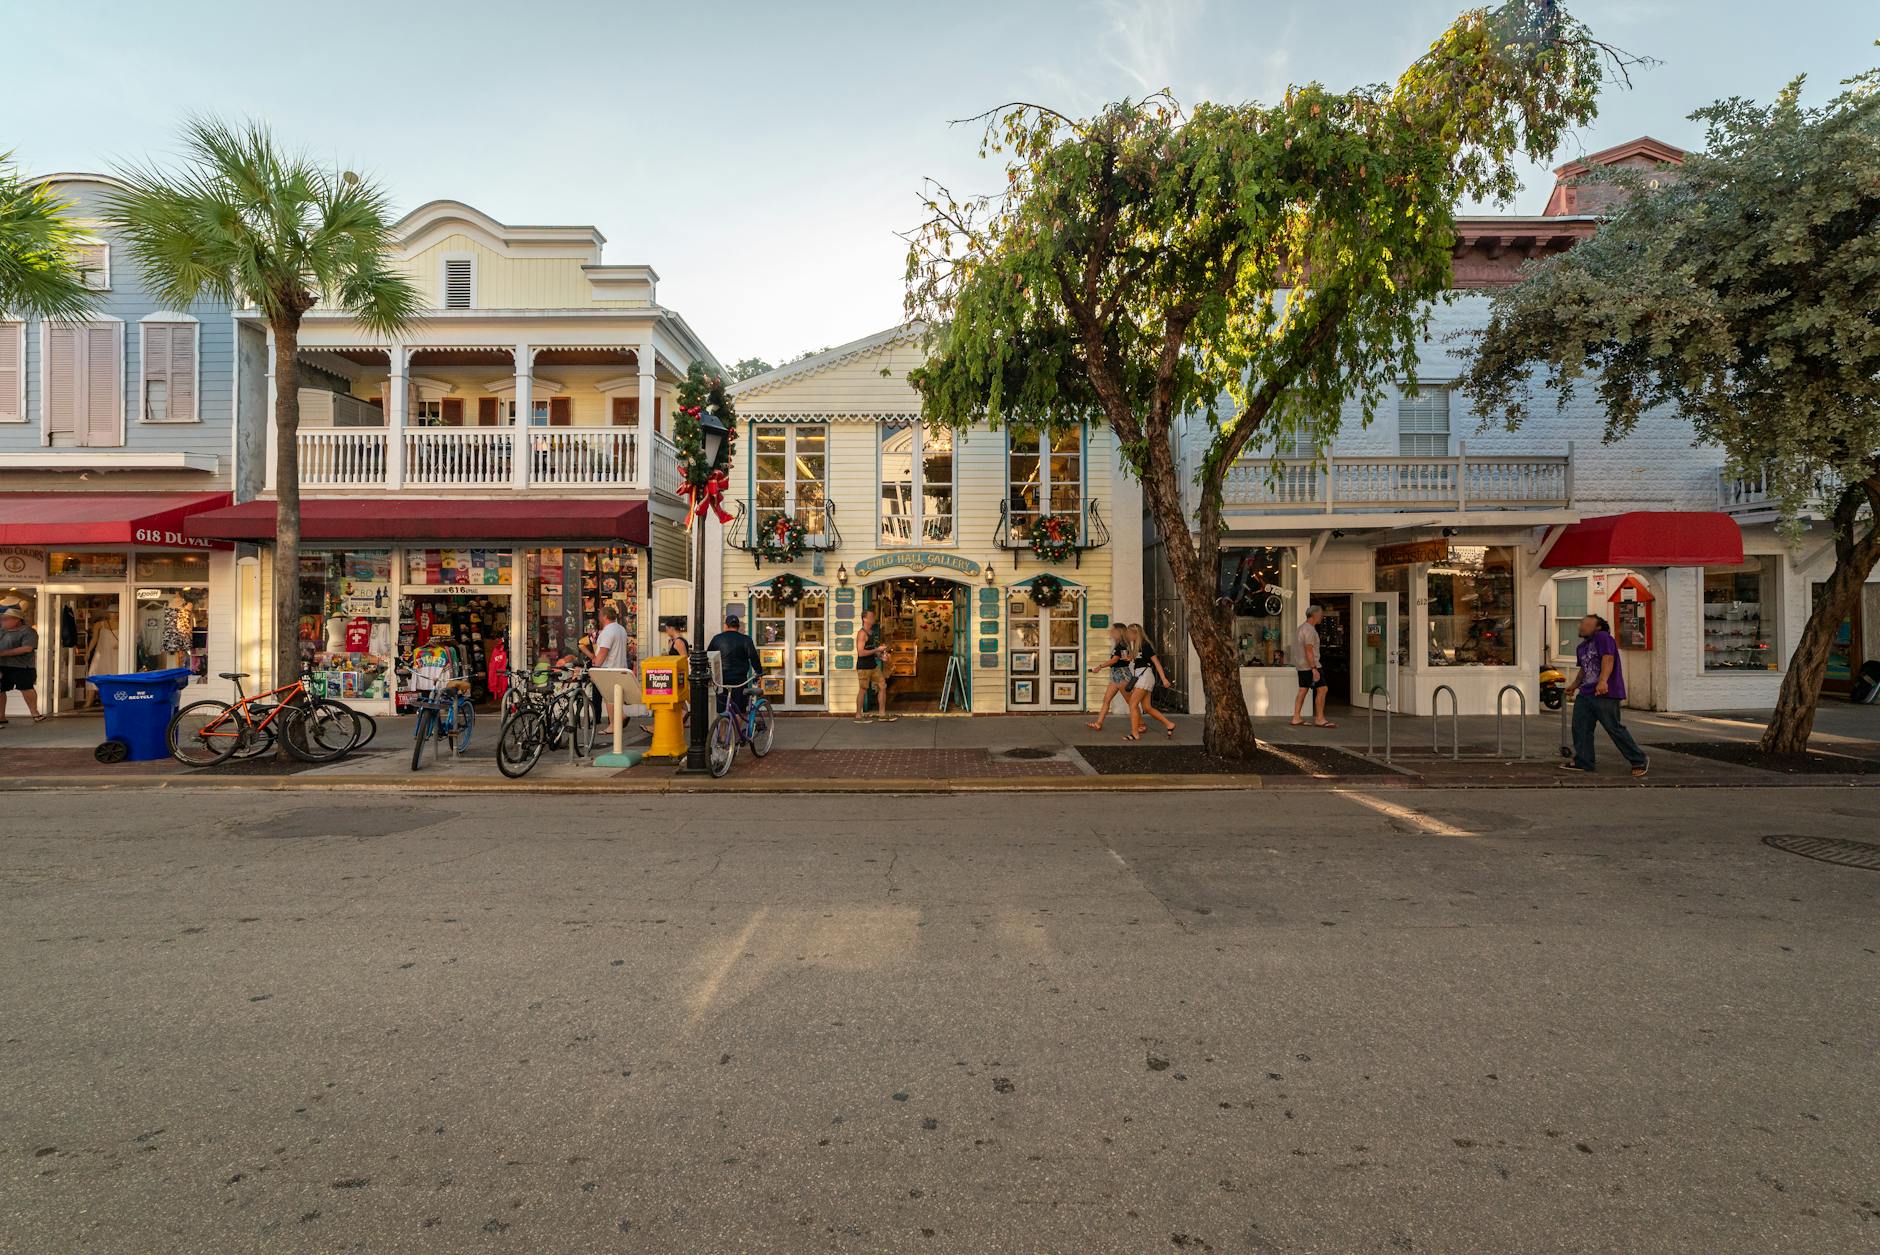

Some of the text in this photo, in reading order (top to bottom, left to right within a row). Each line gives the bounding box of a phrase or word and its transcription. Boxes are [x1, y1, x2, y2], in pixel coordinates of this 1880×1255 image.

[136, 528, 161, 543] 618
[867, 553, 970, 570] GUILD HALL GALLERY
[448, 586, 466, 594] 616
[1416, 598, 1428, 606] 612
[649, 673, 670, 681] Florida
[652, 681, 667, 689] Keys
